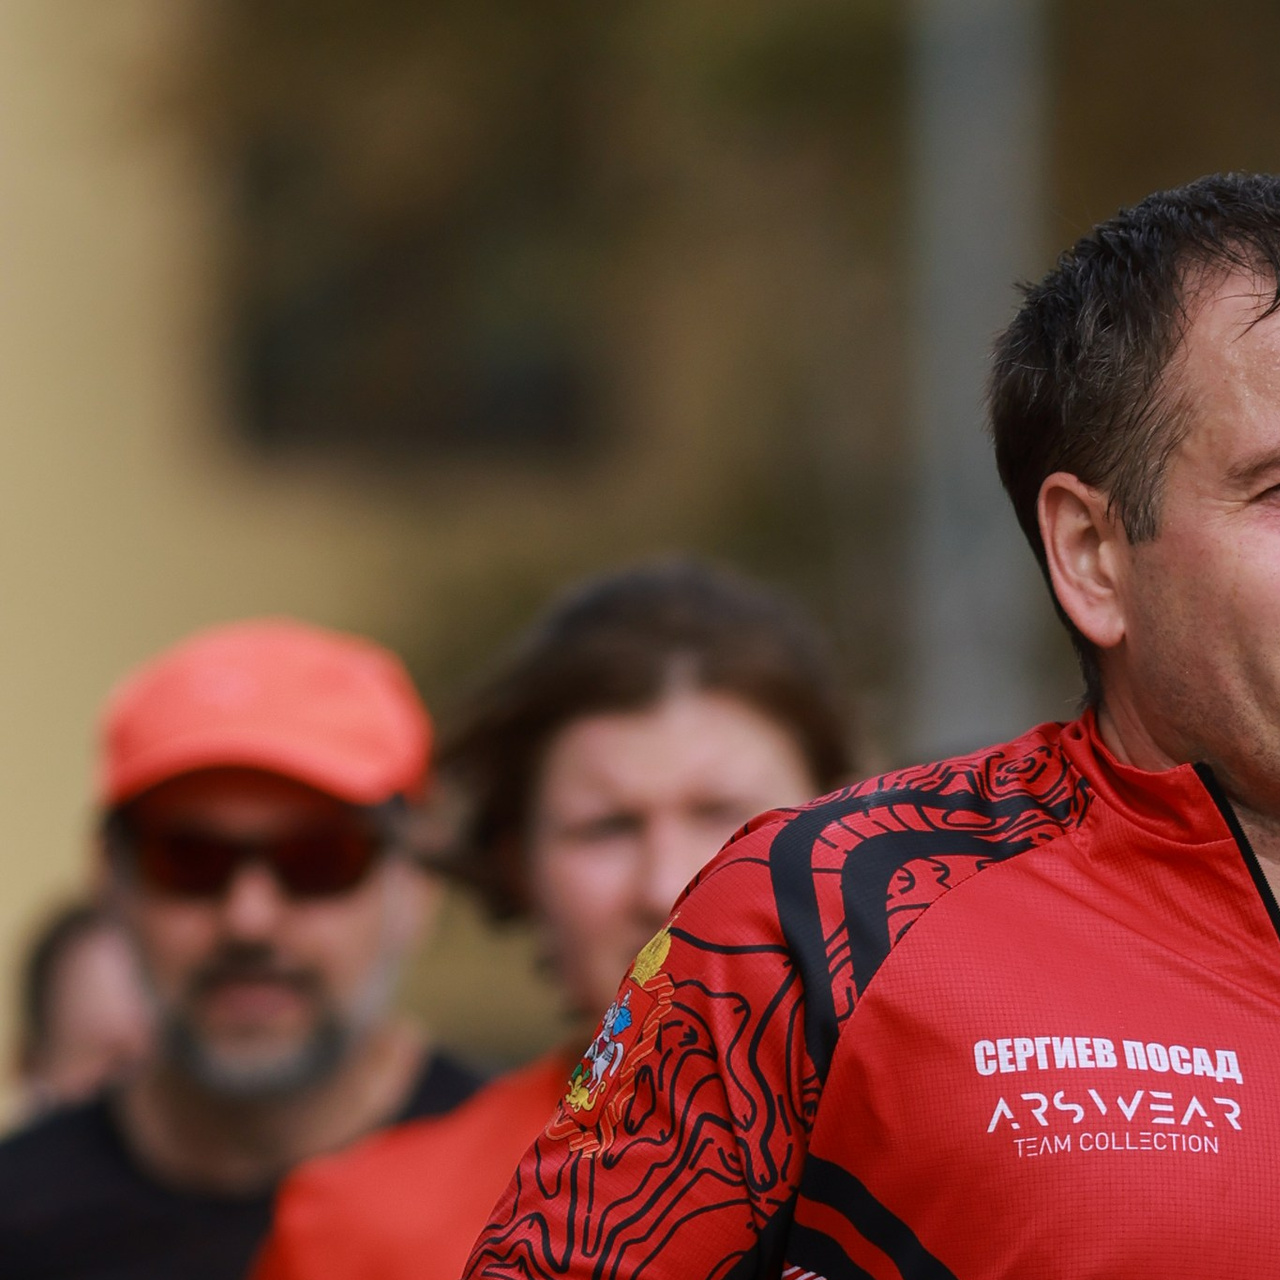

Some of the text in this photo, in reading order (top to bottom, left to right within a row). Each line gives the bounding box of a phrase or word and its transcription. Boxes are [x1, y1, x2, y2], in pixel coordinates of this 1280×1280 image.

[973, 1036, 1244, 1085] СЕРГИЕВ ПОСАД
[1013, 1132, 1219, 1158] TEAM COLLECTION
